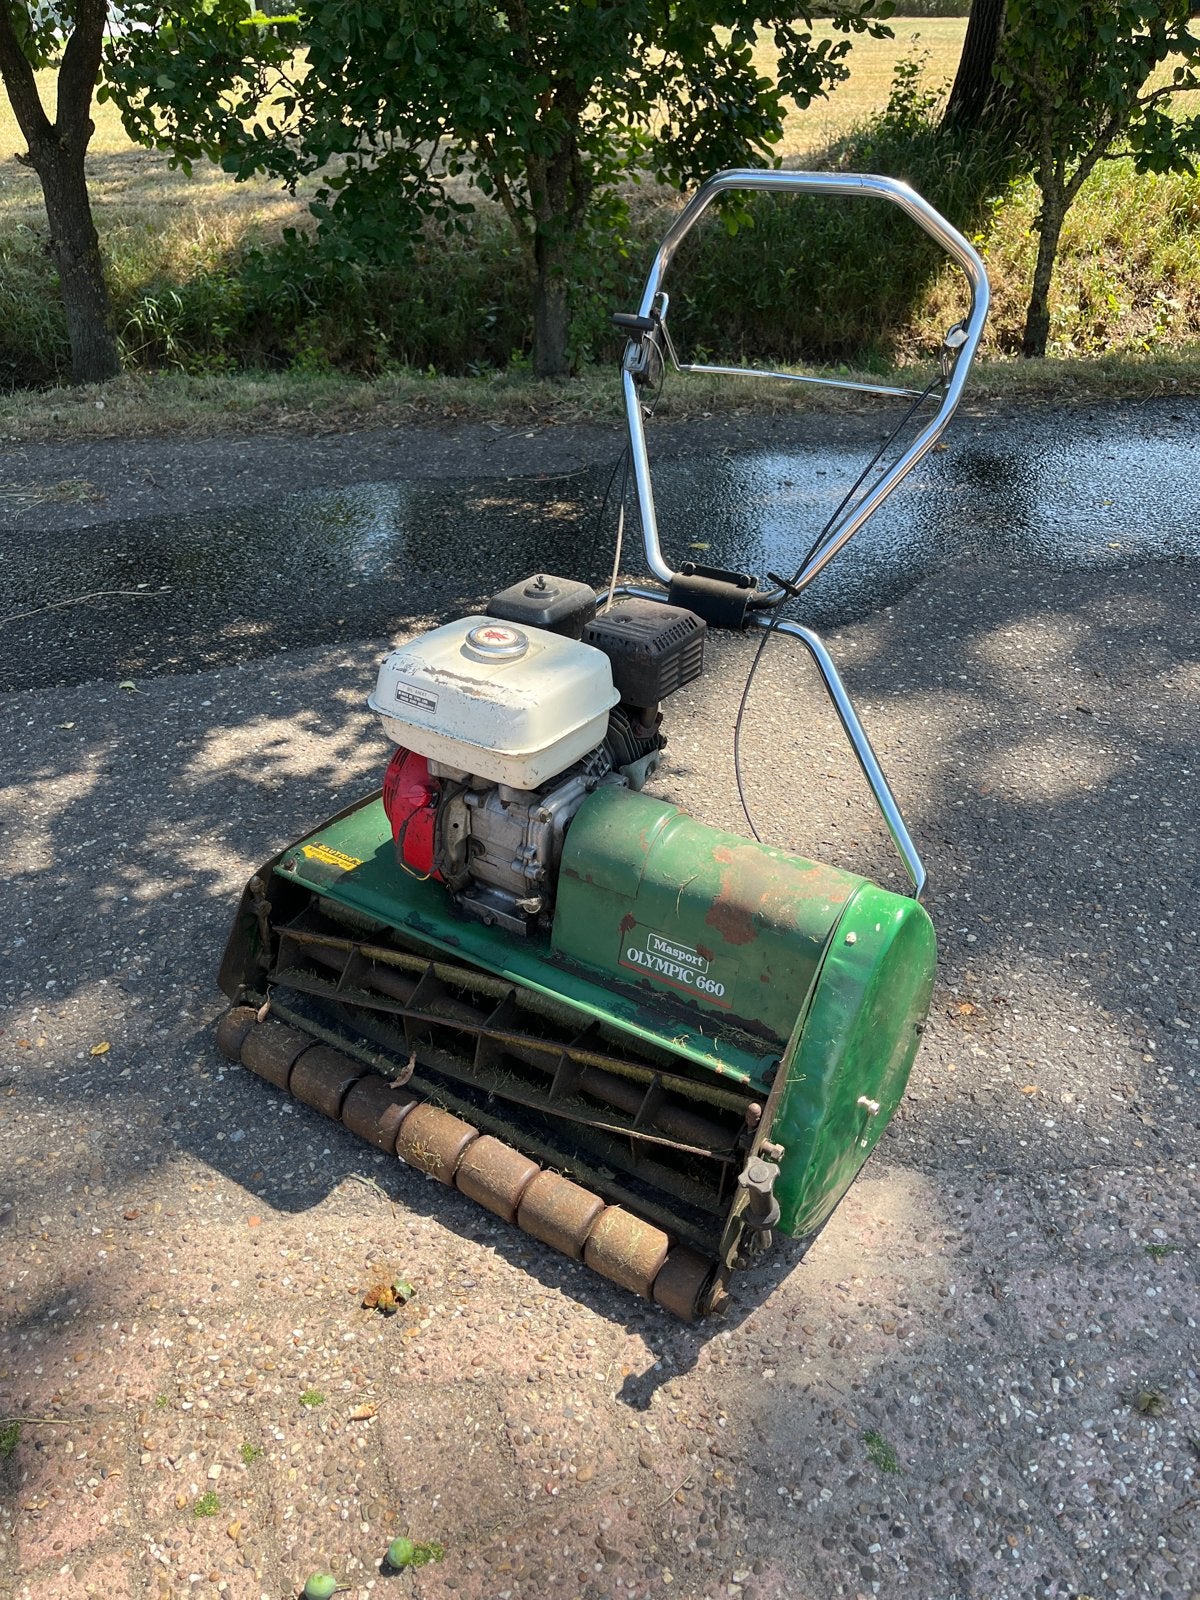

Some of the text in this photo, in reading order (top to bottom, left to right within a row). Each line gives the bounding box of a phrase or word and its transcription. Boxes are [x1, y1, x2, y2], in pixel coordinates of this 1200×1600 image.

[626, 947, 725, 997] OLYMPIC 660
[653, 938, 704, 967] Masport
